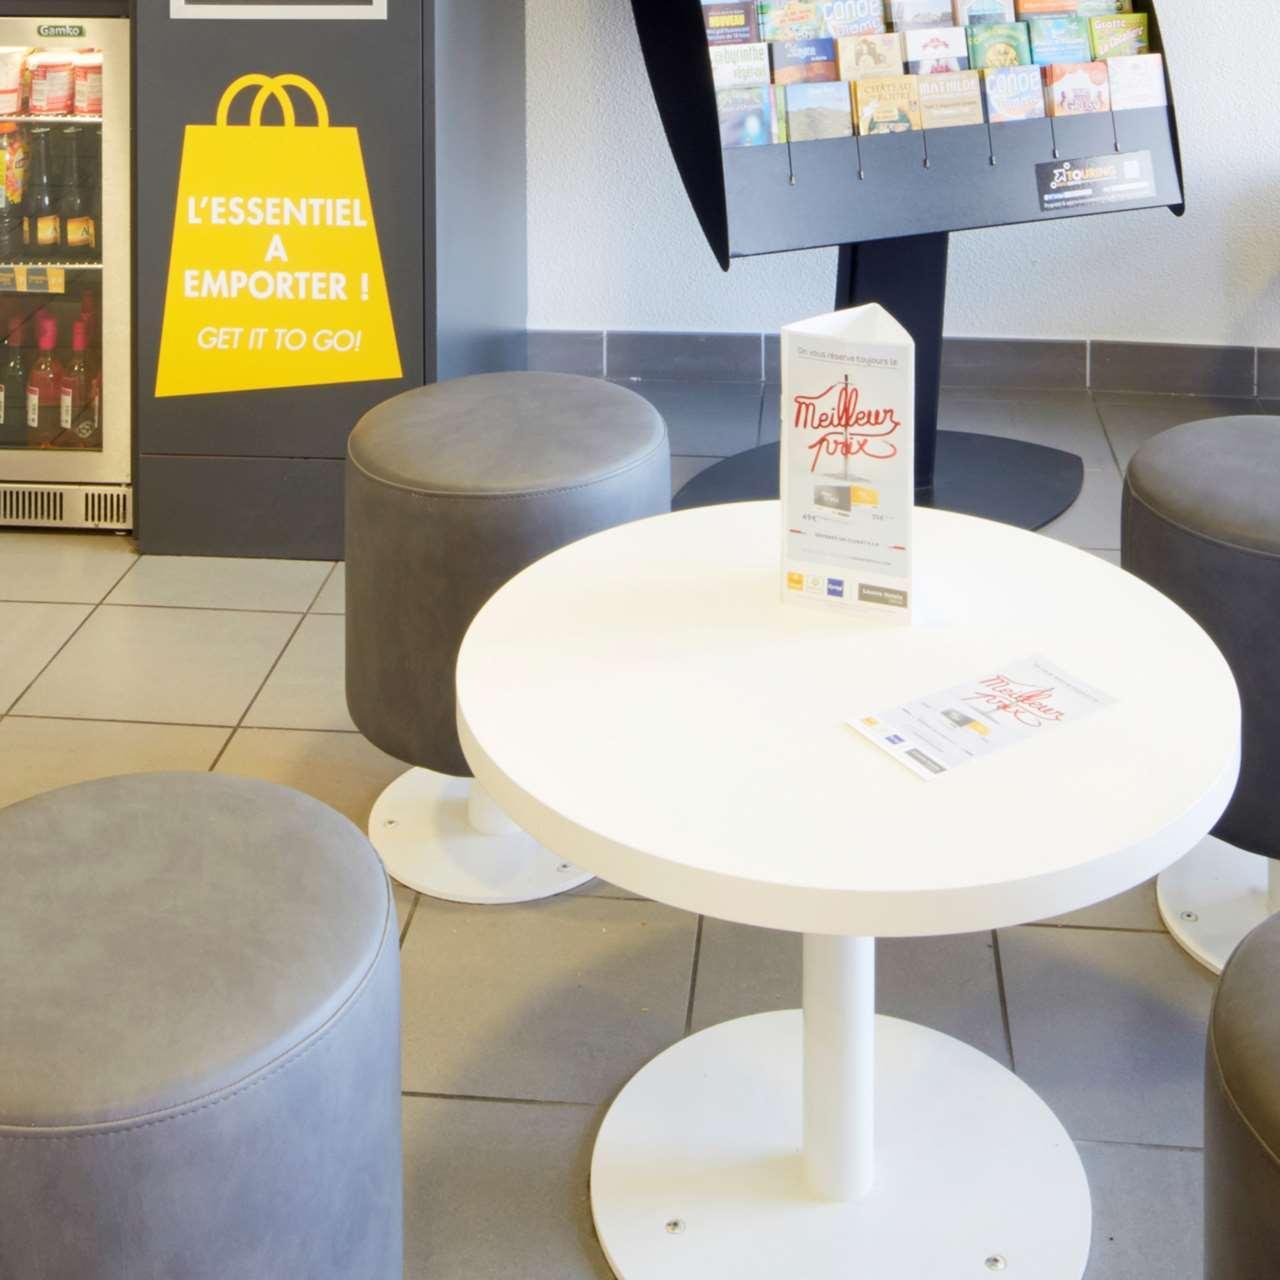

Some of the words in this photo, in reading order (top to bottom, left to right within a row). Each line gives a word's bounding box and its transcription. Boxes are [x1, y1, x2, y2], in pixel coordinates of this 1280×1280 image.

[39, 25, 81, 37] Gamko
[187, 196, 368, 227] L'ESSENTIEL
[264, 234, 289, 262] A
[183, 269, 348, 301] EMPORTER
[360, 272, 370, 301] !
[196, 326, 244, 350] GET
[248, 327, 269, 350] IT
[274, 327, 307, 351] TO
[312, 328, 363, 352] GO!
[793, 385, 902, 429] Meilleur
[808, 432, 897, 473] prix
